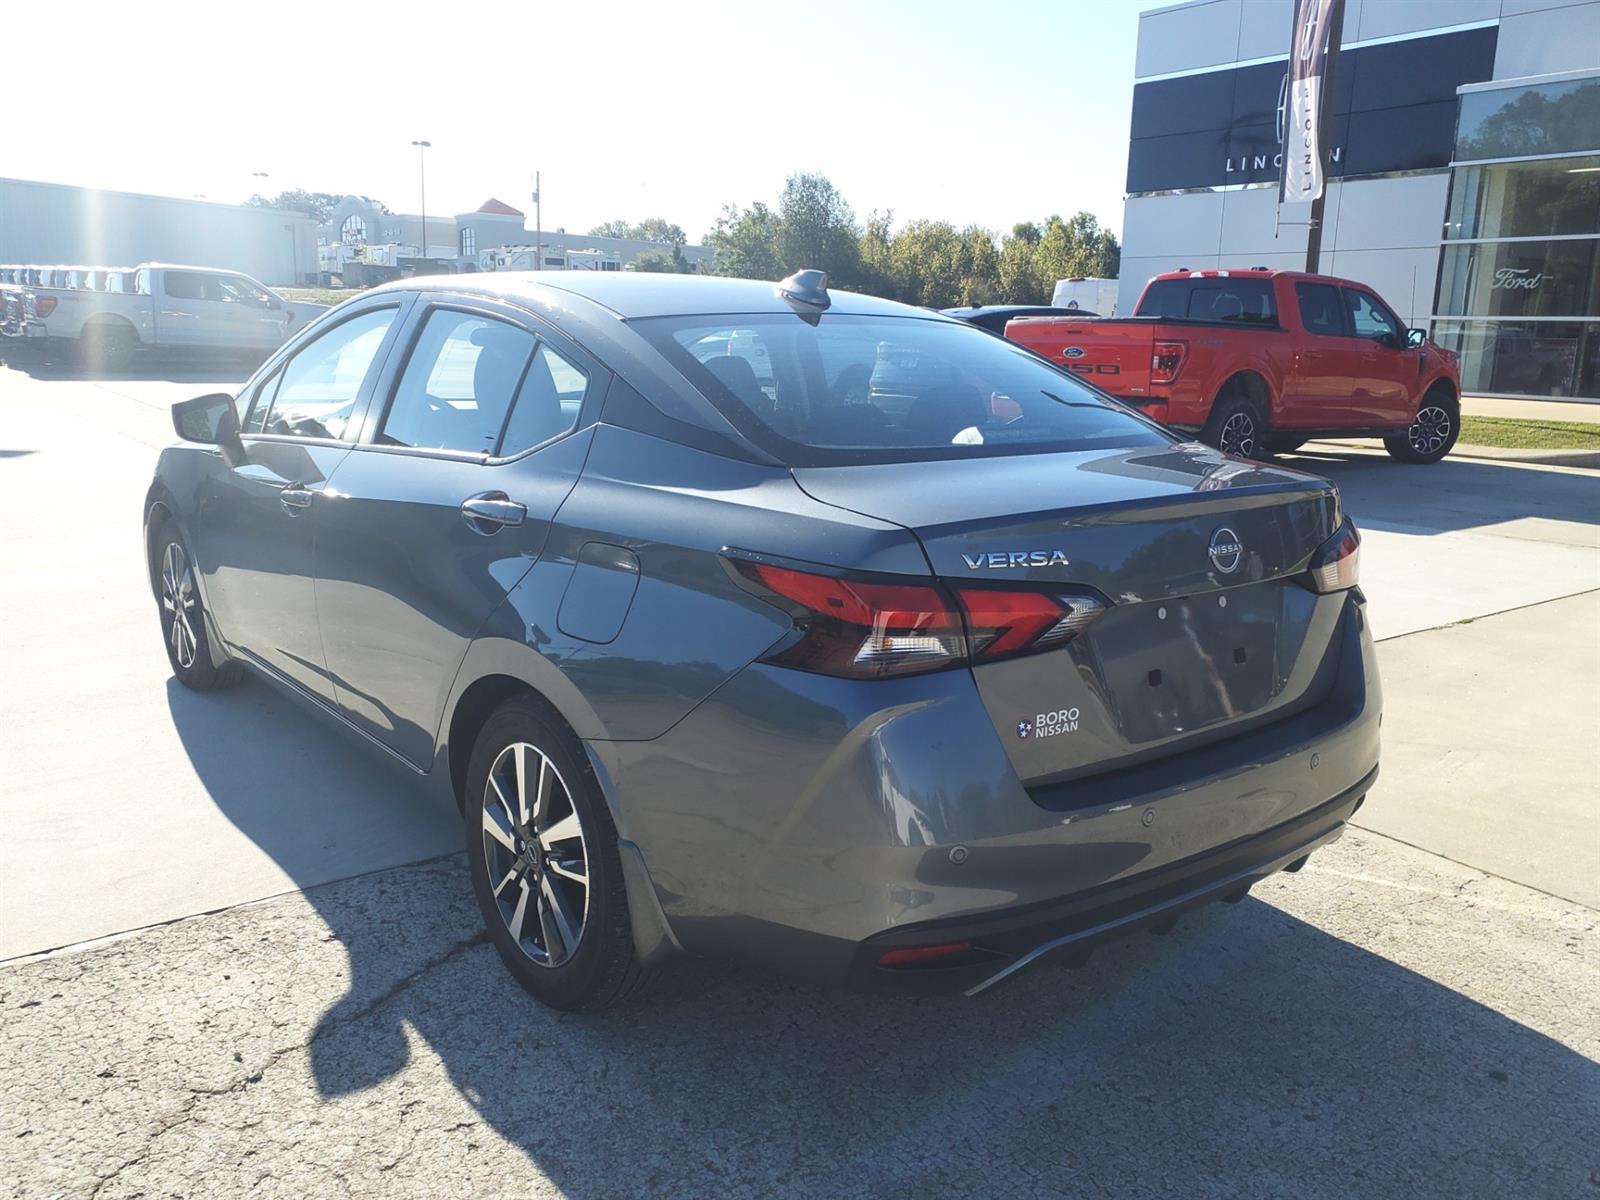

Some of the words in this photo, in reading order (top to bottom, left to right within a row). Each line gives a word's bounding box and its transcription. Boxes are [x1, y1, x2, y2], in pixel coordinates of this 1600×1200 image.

[1226, 147, 1340, 172] LINCN
[1491, 267, 1553, 289] Ford
[961, 550, 1069, 569] VERSA
[1036, 707, 1080, 728] BORO
[1035, 720, 1079, 738] NISSAN
